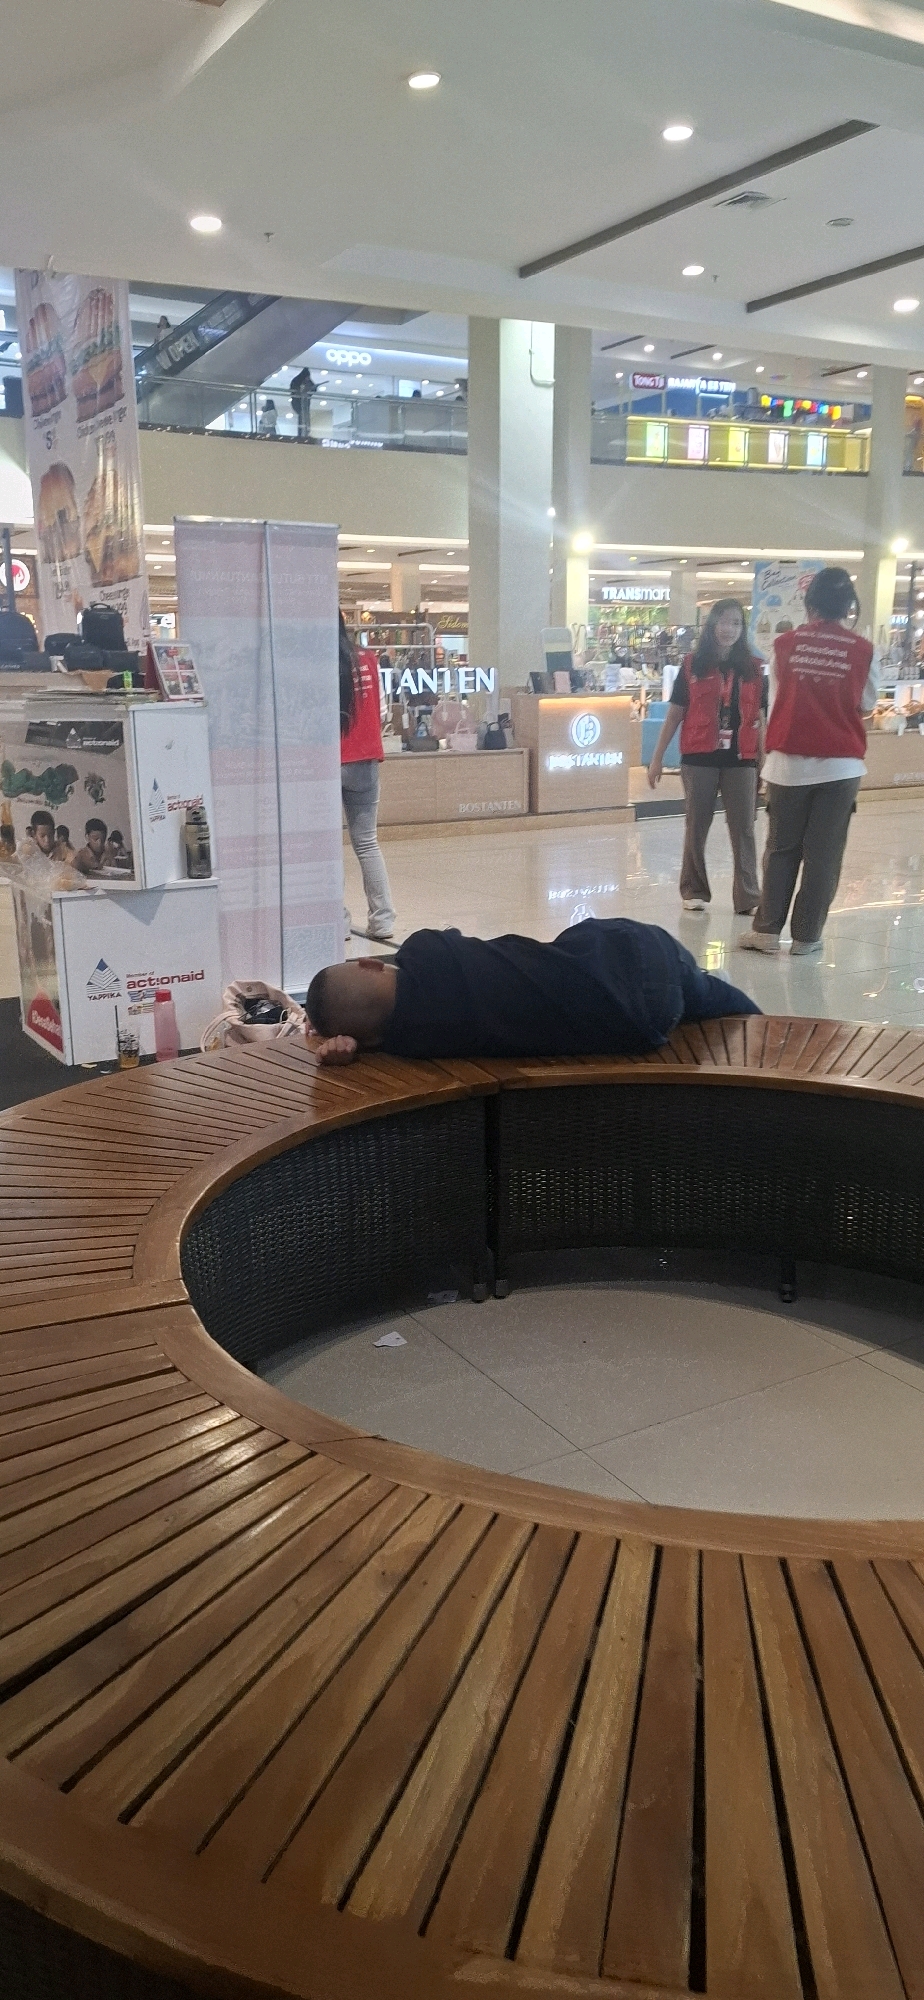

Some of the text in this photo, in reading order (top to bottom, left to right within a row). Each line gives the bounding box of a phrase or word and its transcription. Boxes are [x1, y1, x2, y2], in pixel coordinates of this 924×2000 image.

[326, 349, 372, 367] oppo
[459, 800, 522, 813] BOSTANTEN
[87, 992, 122, 1002] YAPPIKA
